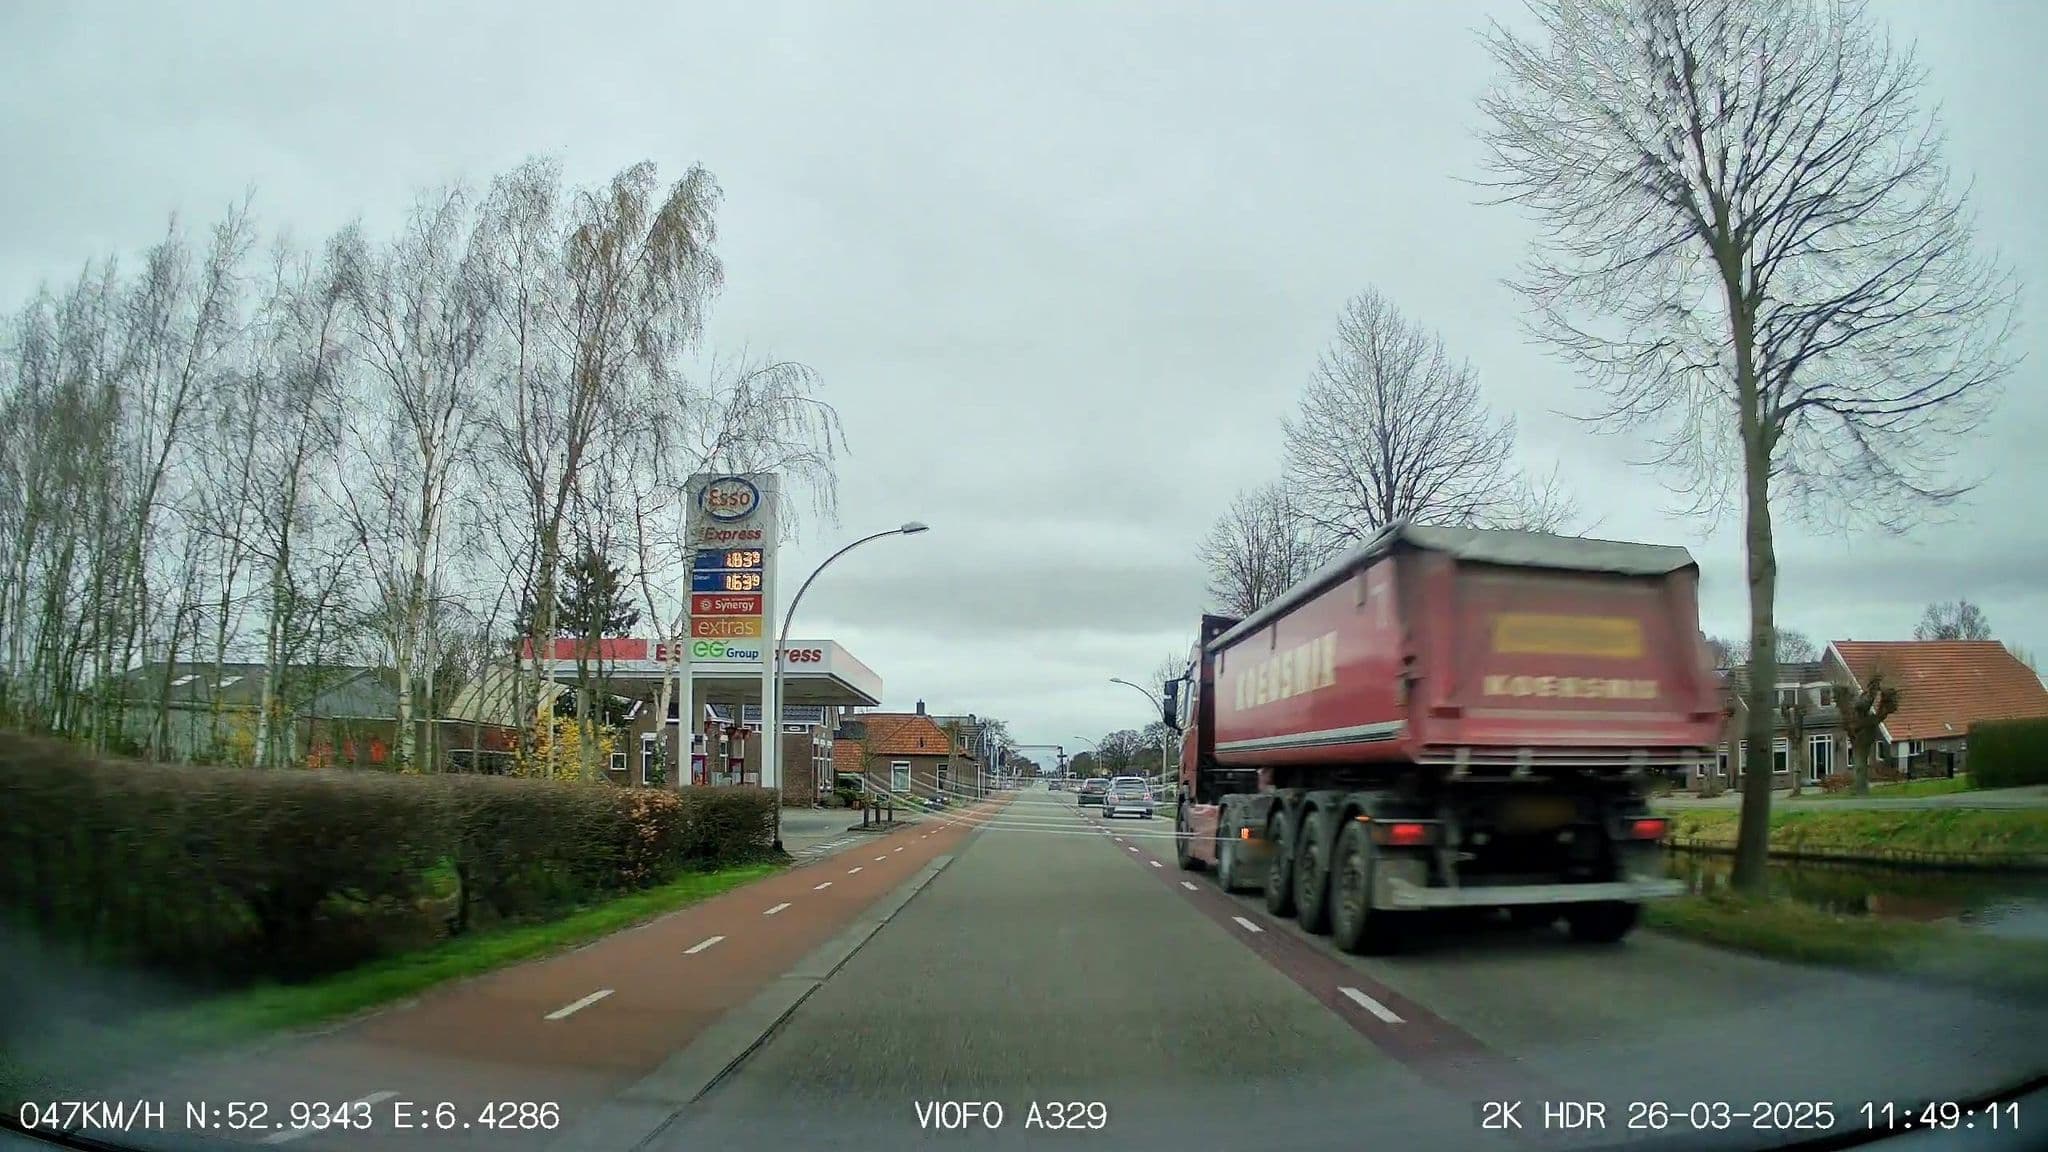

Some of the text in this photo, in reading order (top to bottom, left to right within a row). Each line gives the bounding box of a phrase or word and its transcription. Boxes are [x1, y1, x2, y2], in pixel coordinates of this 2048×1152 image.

[709, 487, 750, 506] Esso
[704, 527, 762, 543] Express
[715, 600, 754, 612] Synergy
[699, 619, 754, 635] extras
[727, 648, 759, 660] Group
